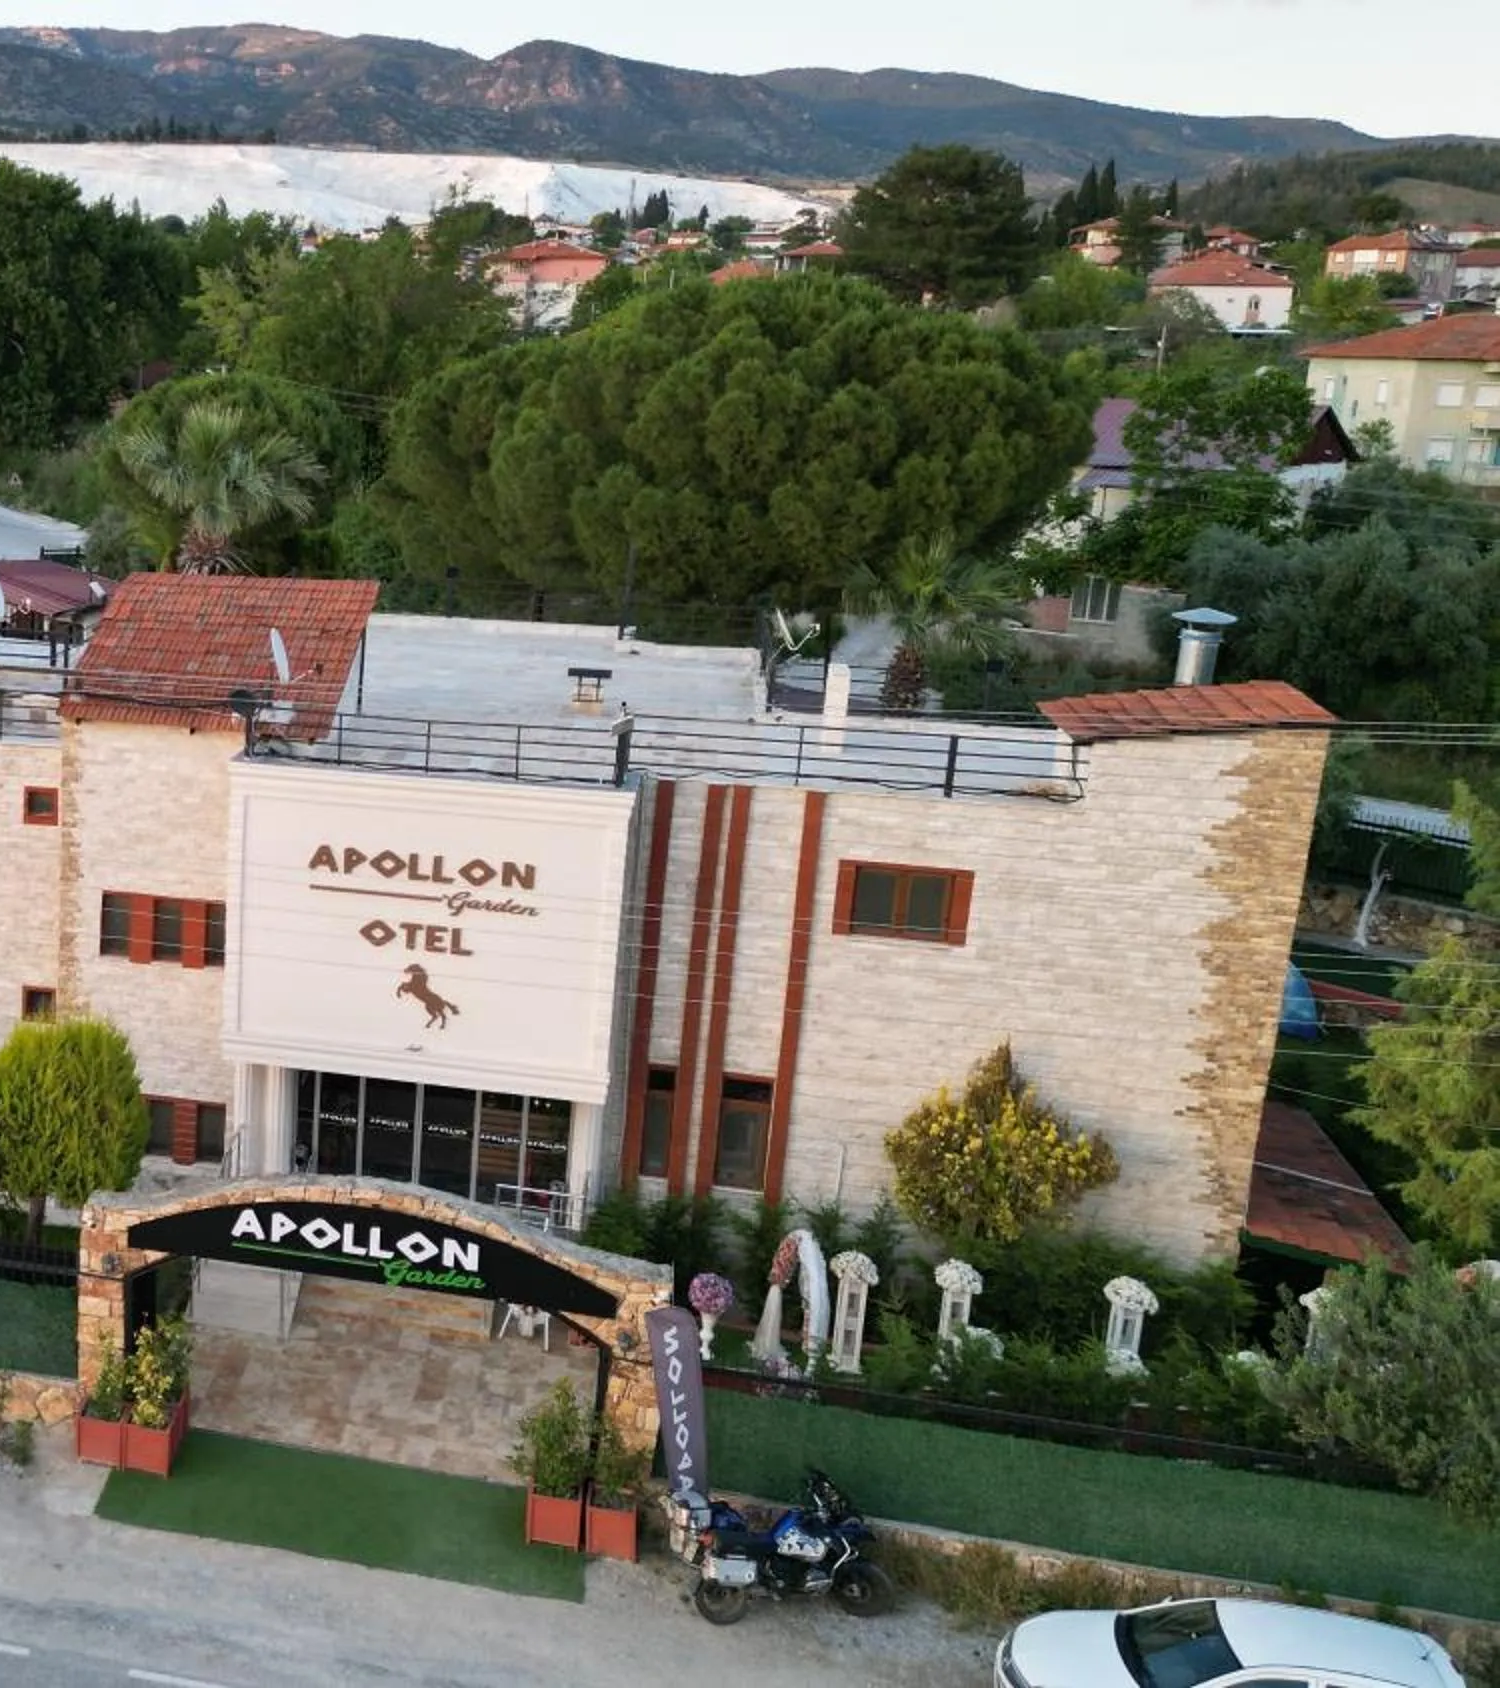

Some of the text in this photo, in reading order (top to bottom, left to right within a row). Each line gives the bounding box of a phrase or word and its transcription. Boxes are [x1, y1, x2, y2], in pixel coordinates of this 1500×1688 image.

[308, 844, 537, 890] APOLLON
[442, 891, 540, 917] Garden
[359, 919, 474, 956] OTEL
[231, 1207, 480, 1272] APOLLON
[379, 1257, 486, 1290] Garden
